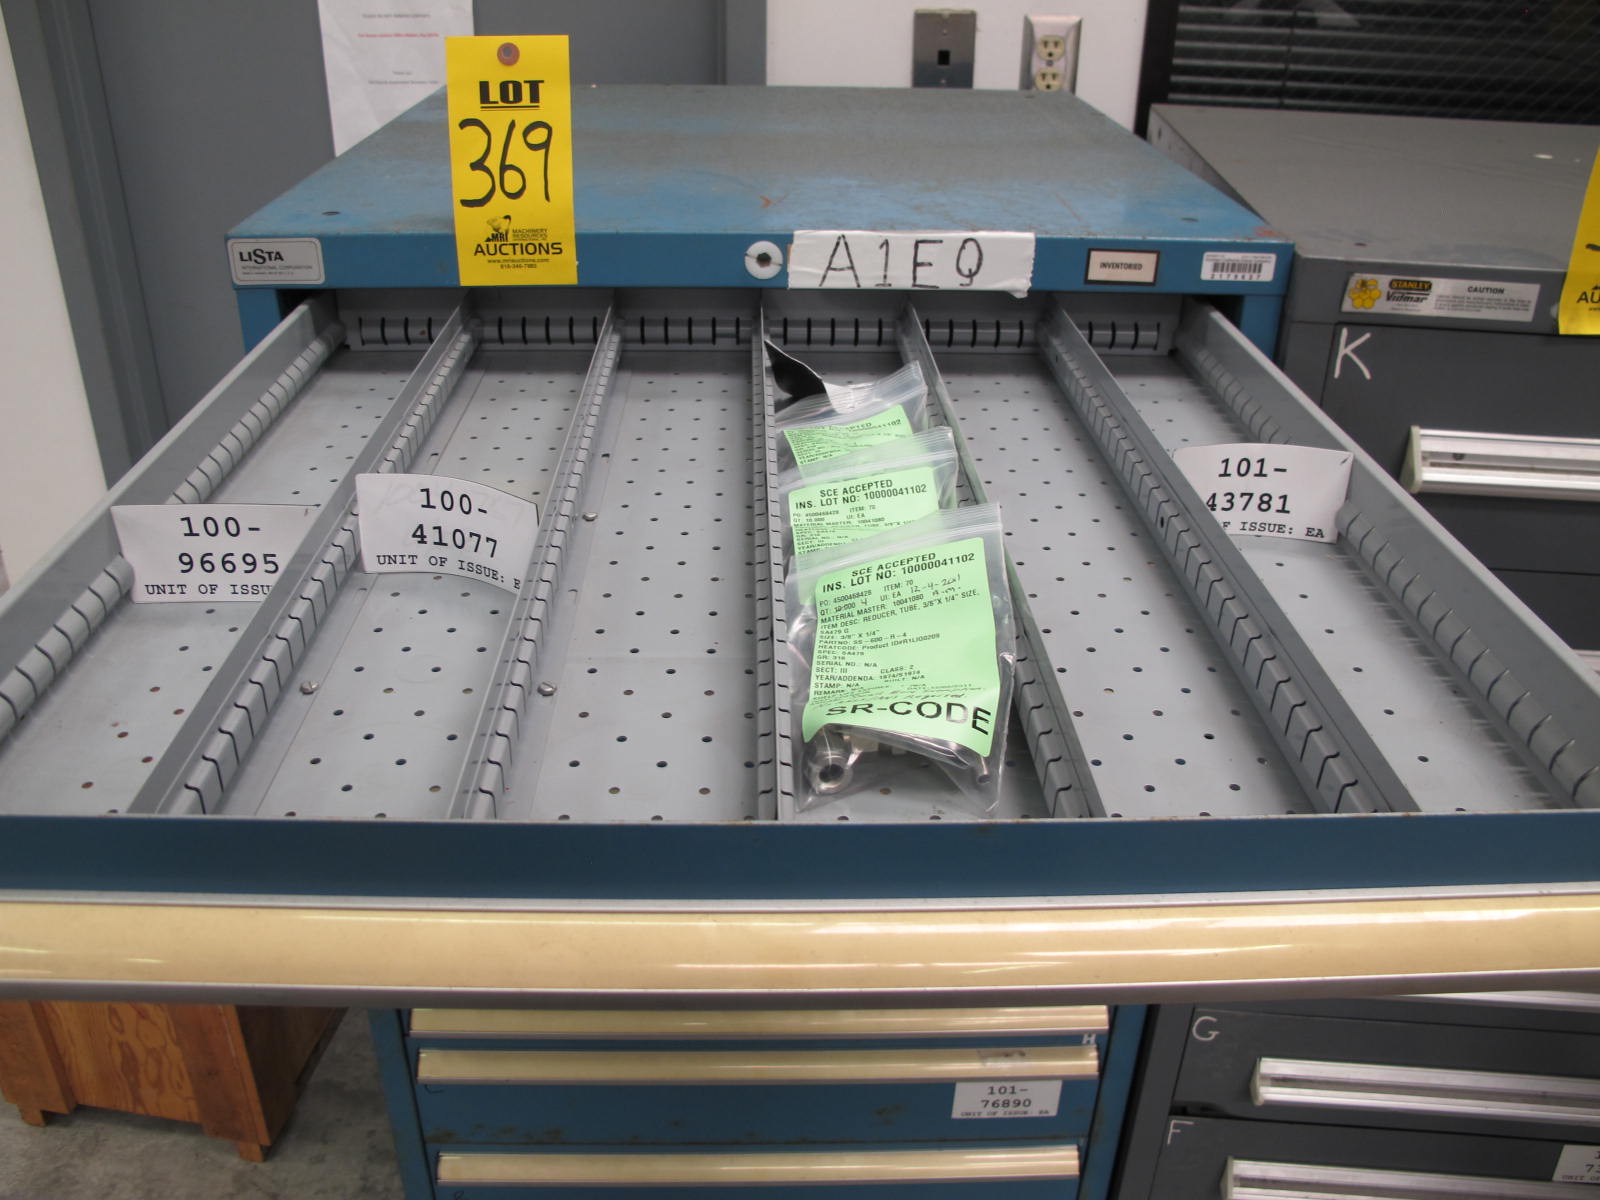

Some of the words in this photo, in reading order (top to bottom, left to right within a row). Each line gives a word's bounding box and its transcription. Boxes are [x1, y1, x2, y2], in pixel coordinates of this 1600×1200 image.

[479, 80, 544, 105] LOT
[458, 118, 553, 208] 369
[239, 248, 284, 265] LISTA
[474, 242, 563, 256] AUCTIONS
[820, 234, 983, 288] A1EQ
[1100, 261, 1143, 271] INVENTORIED
[1391, 280, 1431, 291] STANLEY
[1467, 286, 1505, 294] CAUTION
[1334, 328, 1371, 380] K
[1218, 457, 1287, 478] 101-
[795, 500, 816, 510] INS.
[820, 497, 838, 507] LOT
[842, 494, 861, 504] NO:
[864, 483, 927, 500] 10000041102
[819, 488, 838, 498] SCE
[842, 479, 893, 495] ACCEPTED
[420, 487, 488, 515] 100-
[1206, 491, 1291, 514] 43781
[180, 516, 260, 537] 100-
[1222, 521, 1231, 529] F
[1240, 522, 1293, 535] ISSUE:
[1305, 527, 1325, 538] EA
[411, 524, 498, 558] 41077
[178, 552, 279, 574] 96695
[376, 554, 418, 565] UNIT
[428, 556, 448, 567] OF
[458, 559, 505, 583] ISSUE:
[513, 578, 521, 590] E
[822, 581, 846, 593] INS.
[850, 575, 871, 587] LOT
[876, 569, 896, 582] NO:
[901, 552, 975, 576] 10000041102
[851, 566, 873, 577] SCE
[877, 552, 936, 571] ACCEPTED
[145, 584, 187, 595] UNIT
[198, 584, 218, 595] OF
[230, 584, 273, 595] ISSU
[892, 591, 902, 599] EA
[820, 612, 855, 624] MATERIAL
[825, 700, 991, 735] SR-CODE
[1081, 1033, 1097, 1045] H
[1192, 1016, 1220, 1041] G
[988, 1086, 1028, 1096] 101-
[981, 1098, 1032, 1108] 76890
[1167, 1120, 1195, 1145] F
